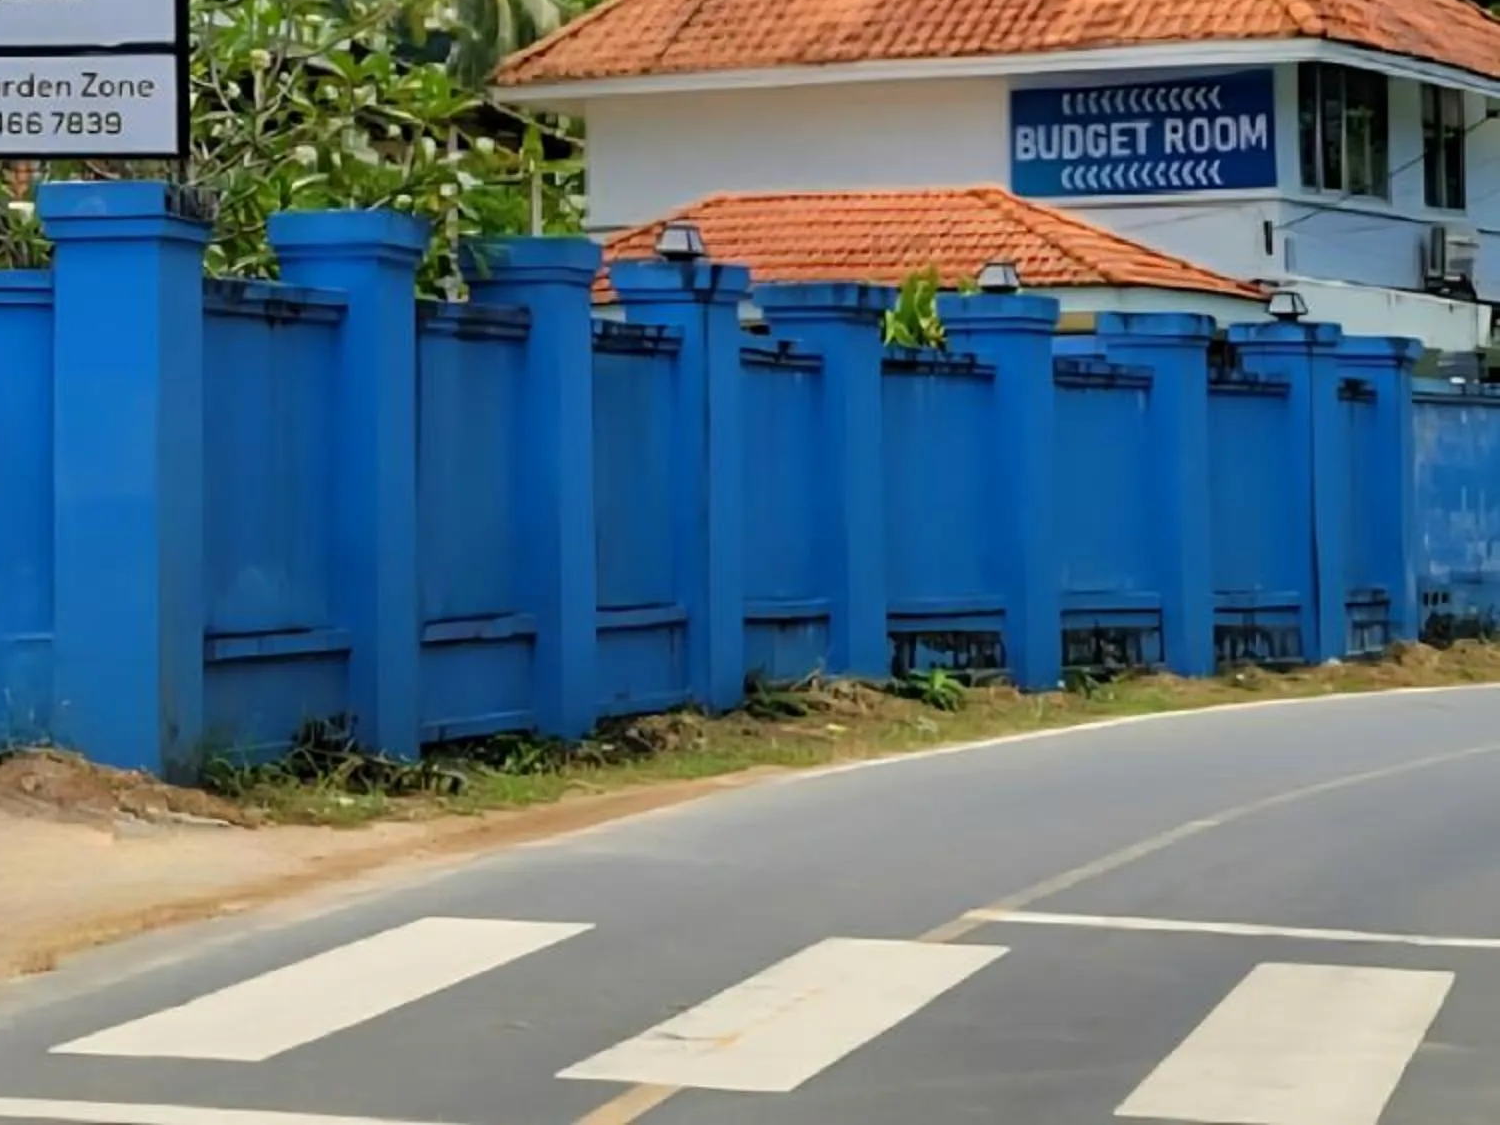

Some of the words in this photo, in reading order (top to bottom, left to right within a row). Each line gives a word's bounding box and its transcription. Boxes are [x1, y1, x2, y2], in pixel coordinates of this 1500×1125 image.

[81, 72, 155, 98] Zone
[51, 111, 122, 135] 7839
[1014, 121, 1151, 161] BUDGET
[1163, 113, 1267, 154] ROOM
